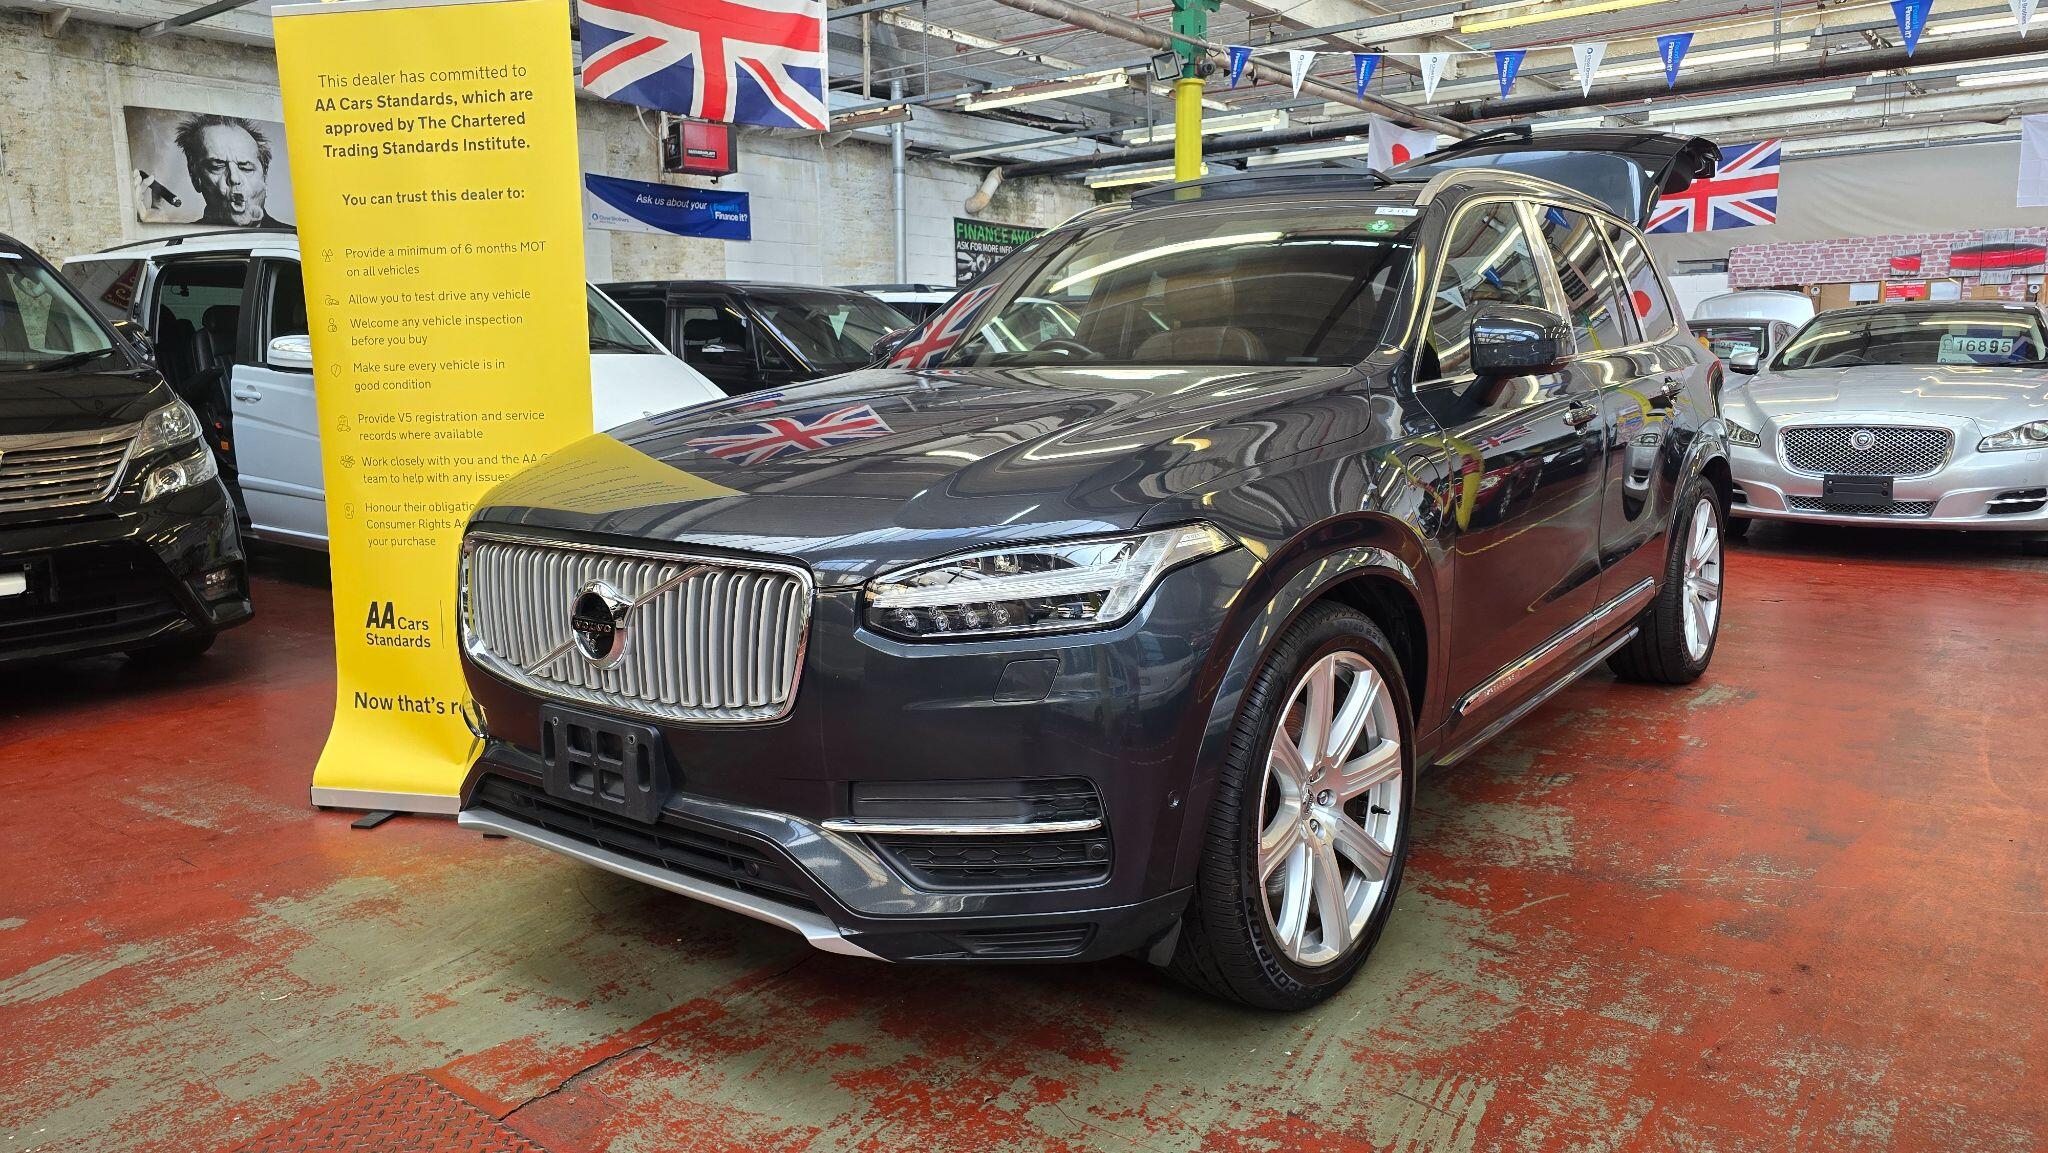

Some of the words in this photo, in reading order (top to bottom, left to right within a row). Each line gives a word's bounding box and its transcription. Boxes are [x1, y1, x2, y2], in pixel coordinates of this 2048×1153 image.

[318, 74, 348, 87] This
[353, 72, 395, 86] dealer
[400, 70, 425, 82] has
[430, 65, 508, 81] committed
[512, 64, 526, 77] to
[315, 98, 336, 112] AA
[340, 97, 372, 110] Cars
[377, 92, 458, 108] Standards,
[462, 89, 506, 104] which
[510, 90, 533, 101] are
[325, 118, 393, 136] approved
[398, 117, 414, 132] by
[418, 116, 446, 129] The
[451, 112, 525, 127] Chartered
[323, 144, 378, 158] Trading
[383, 139, 458, 155] Standards
[464, 136, 530, 151] Institute.
[342, 194, 366, 206] You
[371, 192, 392, 204] can
[396, 190, 427, 203] trust
[431, 189, 456, 201] this
[461, 188, 503, 200] dealer
[507, 187, 524, 199] to:
[636, 194, 653, 205] Ask
[654, 198, 665, 206] us
[666, 197, 689, 208] about
[690, 201, 708, 211] your
[715, 211, 739, 221] Finance
[739, 213, 748, 222] it?
[957, 222, 1008, 243] FINANCE
[346, 248, 385, 258] Provide
[397, 245, 446, 256] minimum
[451, 244, 463, 254] of
[464, 244, 472, 253] 6
[476, 243, 517, 253] months
[520, 241, 546, 251] MOT
[956, 241, 969, 250] ASK
[970, 242, 983, 252] FOR
[983, 244, 999, 253] MORE
[347, 268, 360, 277] on
[363, 266, 375, 276] all
[377, 264, 419, 275] vehicles
[349, 294, 377, 304] Allow
[380, 293, 398, 305] you
[401, 292, 411, 302] to
[414, 291, 435, 301] test
[438, 291, 466, 301] drive
[470, 290, 489, 302] any
[492, 289, 530, 299] vehicle
[350, 317, 398, 328] Welcome
[402, 318, 419, 328] any
[422, 315, 461, 325] vehicle
[465, 314, 522, 327] inspection
[352, 336, 384, 346] before
[387, 336, 405, 347] you
[409, 334, 427, 347] buy
[354, 362, 381, 373] Make
[383, 362, 405, 372] sure
[408, 361, 436, 373] every
[439, 360, 479, 369] vehicle
[483, 359, 492, 369] is
[495, 359, 504, 369] in
[355, 380, 380, 393] good
[383, 379, 431, 390] condition
[358, 413, 395, 424] Provide
[398, 413, 412, 423] V5
[415, 412, 477, 424] registration
[482, 411, 502, 421] and
[505, 411, 545, 421] service
[360, 431, 397, 441] records
[399, 430, 431, 440] where
[434, 429, 484, 439] available
[362, 457, 388, 467] Work
[390, 456, 425, 469] closely
[427, 455, 451, 466] with
[453, 456, 473, 468] you
[478, 454, 499, 465] and
[501, 454, 519, 464] the
[522, 453, 538, 464] AA
[364, 474, 387, 484] team
[390, 474, 400, 483] to
[403, 473, 424, 485] help
[427, 472, 449, 483] with
[453, 473, 472, 484] any
[365, 503, 401, 513] Honour
[404, 502, 425, 512] their
[366, 520, 415, 529] Consumer
[418, 519, 451, 532] Rights
[368, 537, 388, 547] your
[391, 536, 436, 547] purchase
[366, 601, 395, 629] AA
[397, 617, 429, 630] Cars
[577, 620, 611, 632] VOLVO
[366, 633, 431, 647] Standards
[355, 692, 393, 711] Now
[398, 695, 445, 714] that's
